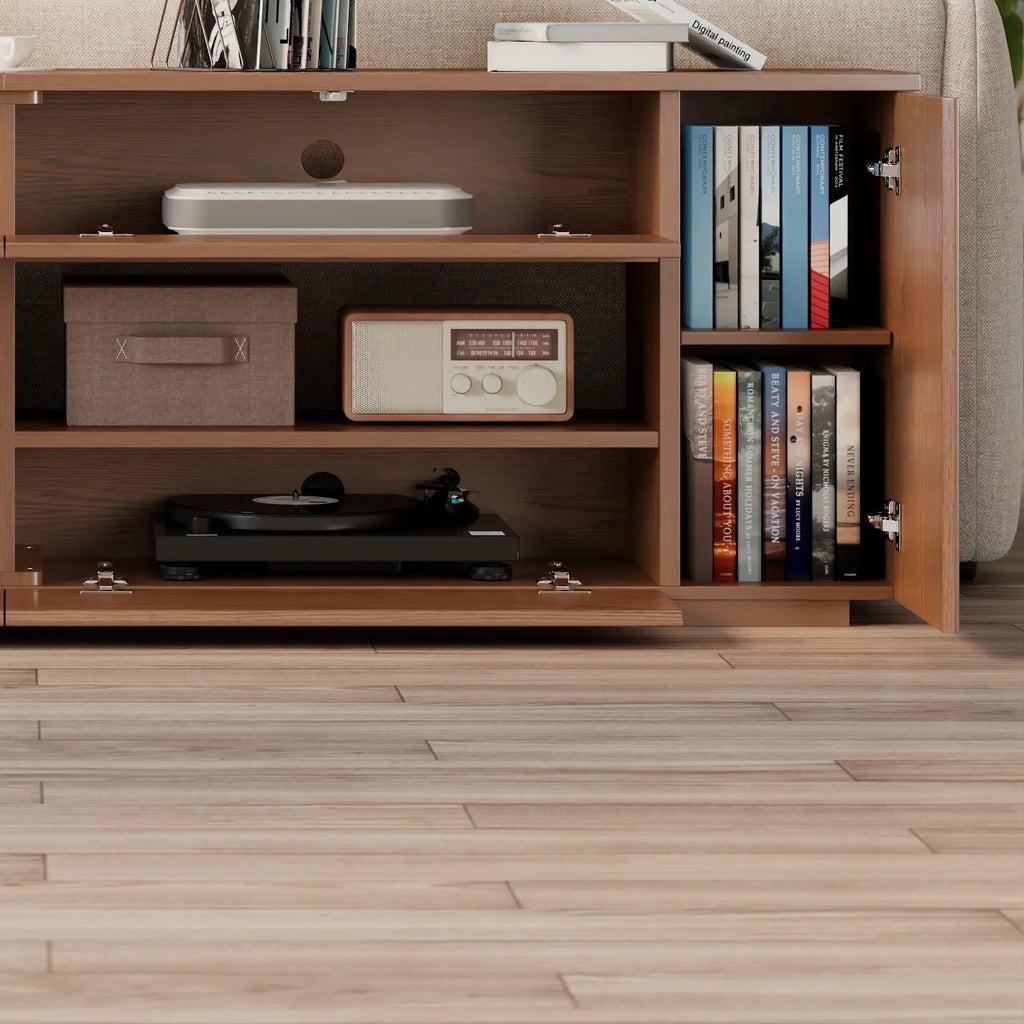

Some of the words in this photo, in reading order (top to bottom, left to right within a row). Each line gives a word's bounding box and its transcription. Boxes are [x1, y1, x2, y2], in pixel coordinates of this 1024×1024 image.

[691, 19, 719, 41] Digital
[717, 37, 751, 62] painting
[771, 373, 780, 407] BEATY
[771, 411, 780, 434] AND
[722, 418, 732, 478] SOMETHING
[745, 444, 754, 482] SUMMER
[771, 436, 780, 466] STEVE
[847, 445, 856, 476] NEVER
[771, 474, 780, 488] ON
[847, 479, 856, 517] ENDING
[722, 482, 732, 516] ABOUT
[745, 485, 753, 531] HOLIDAYS
[722, 518, 732, 543] YOU
[771, 492, 780, 543] VACATION
